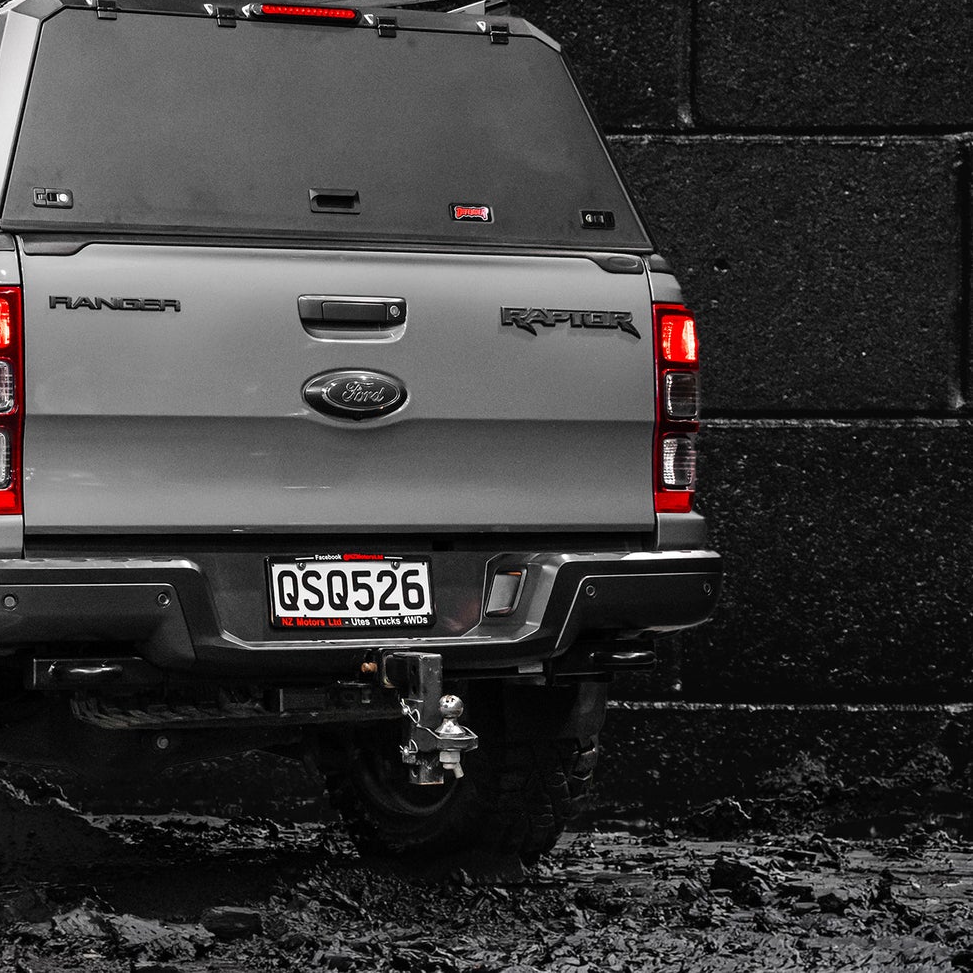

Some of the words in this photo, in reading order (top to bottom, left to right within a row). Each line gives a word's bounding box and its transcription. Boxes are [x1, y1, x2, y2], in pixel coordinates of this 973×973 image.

[49, 295, 181, 312] RANGER
[500, 305, 641, 340] RAPTOR
[341, 381, 385, 403] Ford
[277, 569, 425, 612] QSQ526
[281, 617, 294, 626] NZ
[296, 617, 326, 626] Motors
[328, 618, 342, 626] Ltd
[351, 617, 370, 626] Utes
[372, 616, 401, 625] Trucks
[403, 615, 428, 624] 4WDs
